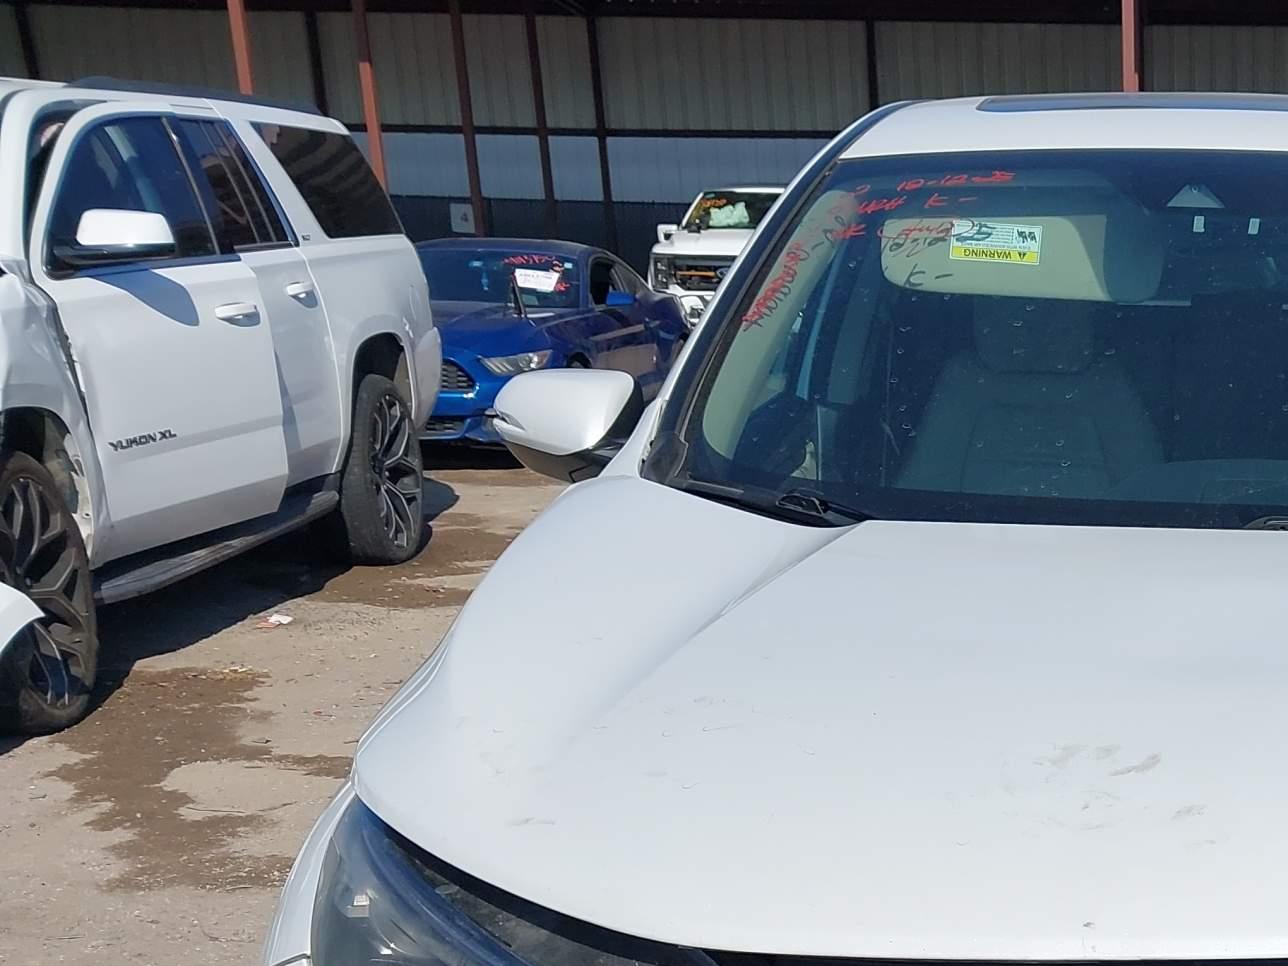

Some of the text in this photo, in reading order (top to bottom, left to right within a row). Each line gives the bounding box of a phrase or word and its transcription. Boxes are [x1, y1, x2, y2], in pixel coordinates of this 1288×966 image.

[963, 248, 1012, 260] WARNING
[108, 429, 178, 451] YUKON XL
